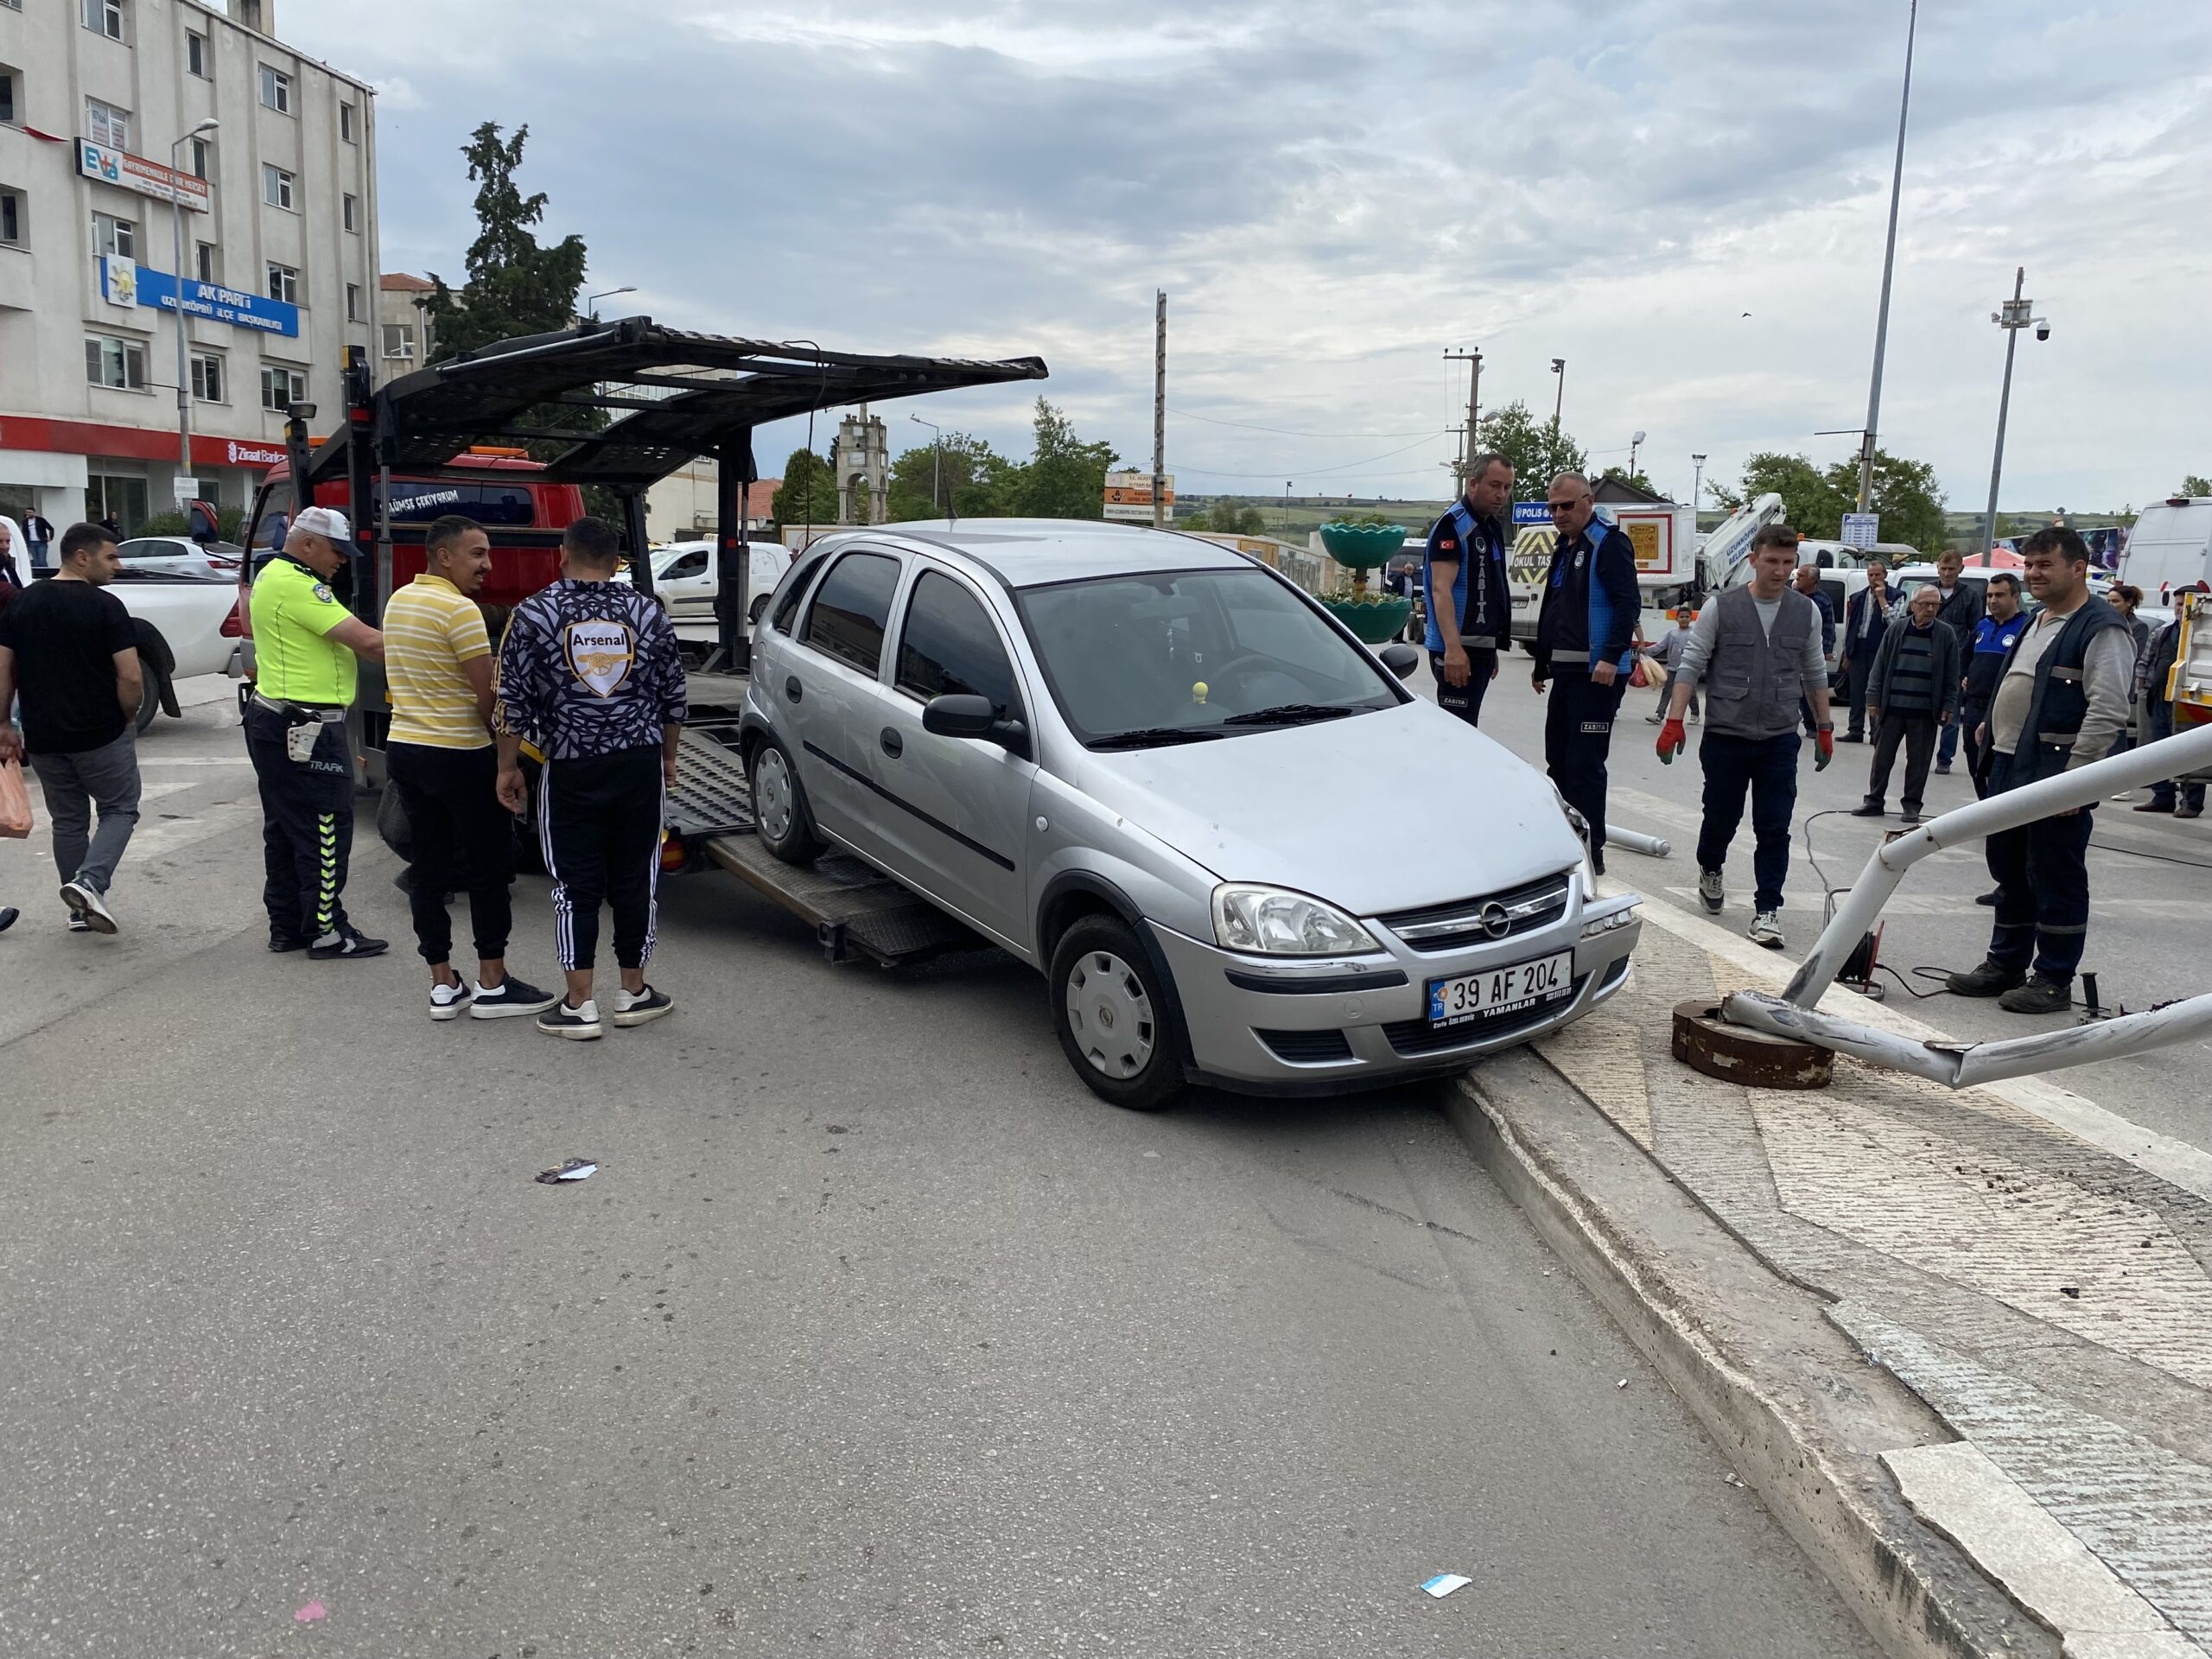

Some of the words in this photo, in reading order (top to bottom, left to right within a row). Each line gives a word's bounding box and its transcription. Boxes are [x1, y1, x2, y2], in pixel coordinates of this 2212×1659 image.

[197, 284, 216, 302] AK
[218, 289, 251, 308] PARTİ
[217, 308, 234, 321] İLÇE
[238, 448, 261, 462] Ziraat
[379, 499, 415, 513] LÜMSE
[416, 490, 459, 509] ÇEKİYORUM
[1514, 556, 1534, 567] OKUL
[1476, 555, 1487, 624] ZABITA
[573, 633, 625, 646] Arsenal
[1453, 979, 1479, 1010] 39
[1491, 970, 1516, 1003] AF
[1523, 959, 1558, 995] 204
[1433, 1002, 1443, 1012] TR
[1483, 998, 1535, 1018] YAMANLAR
